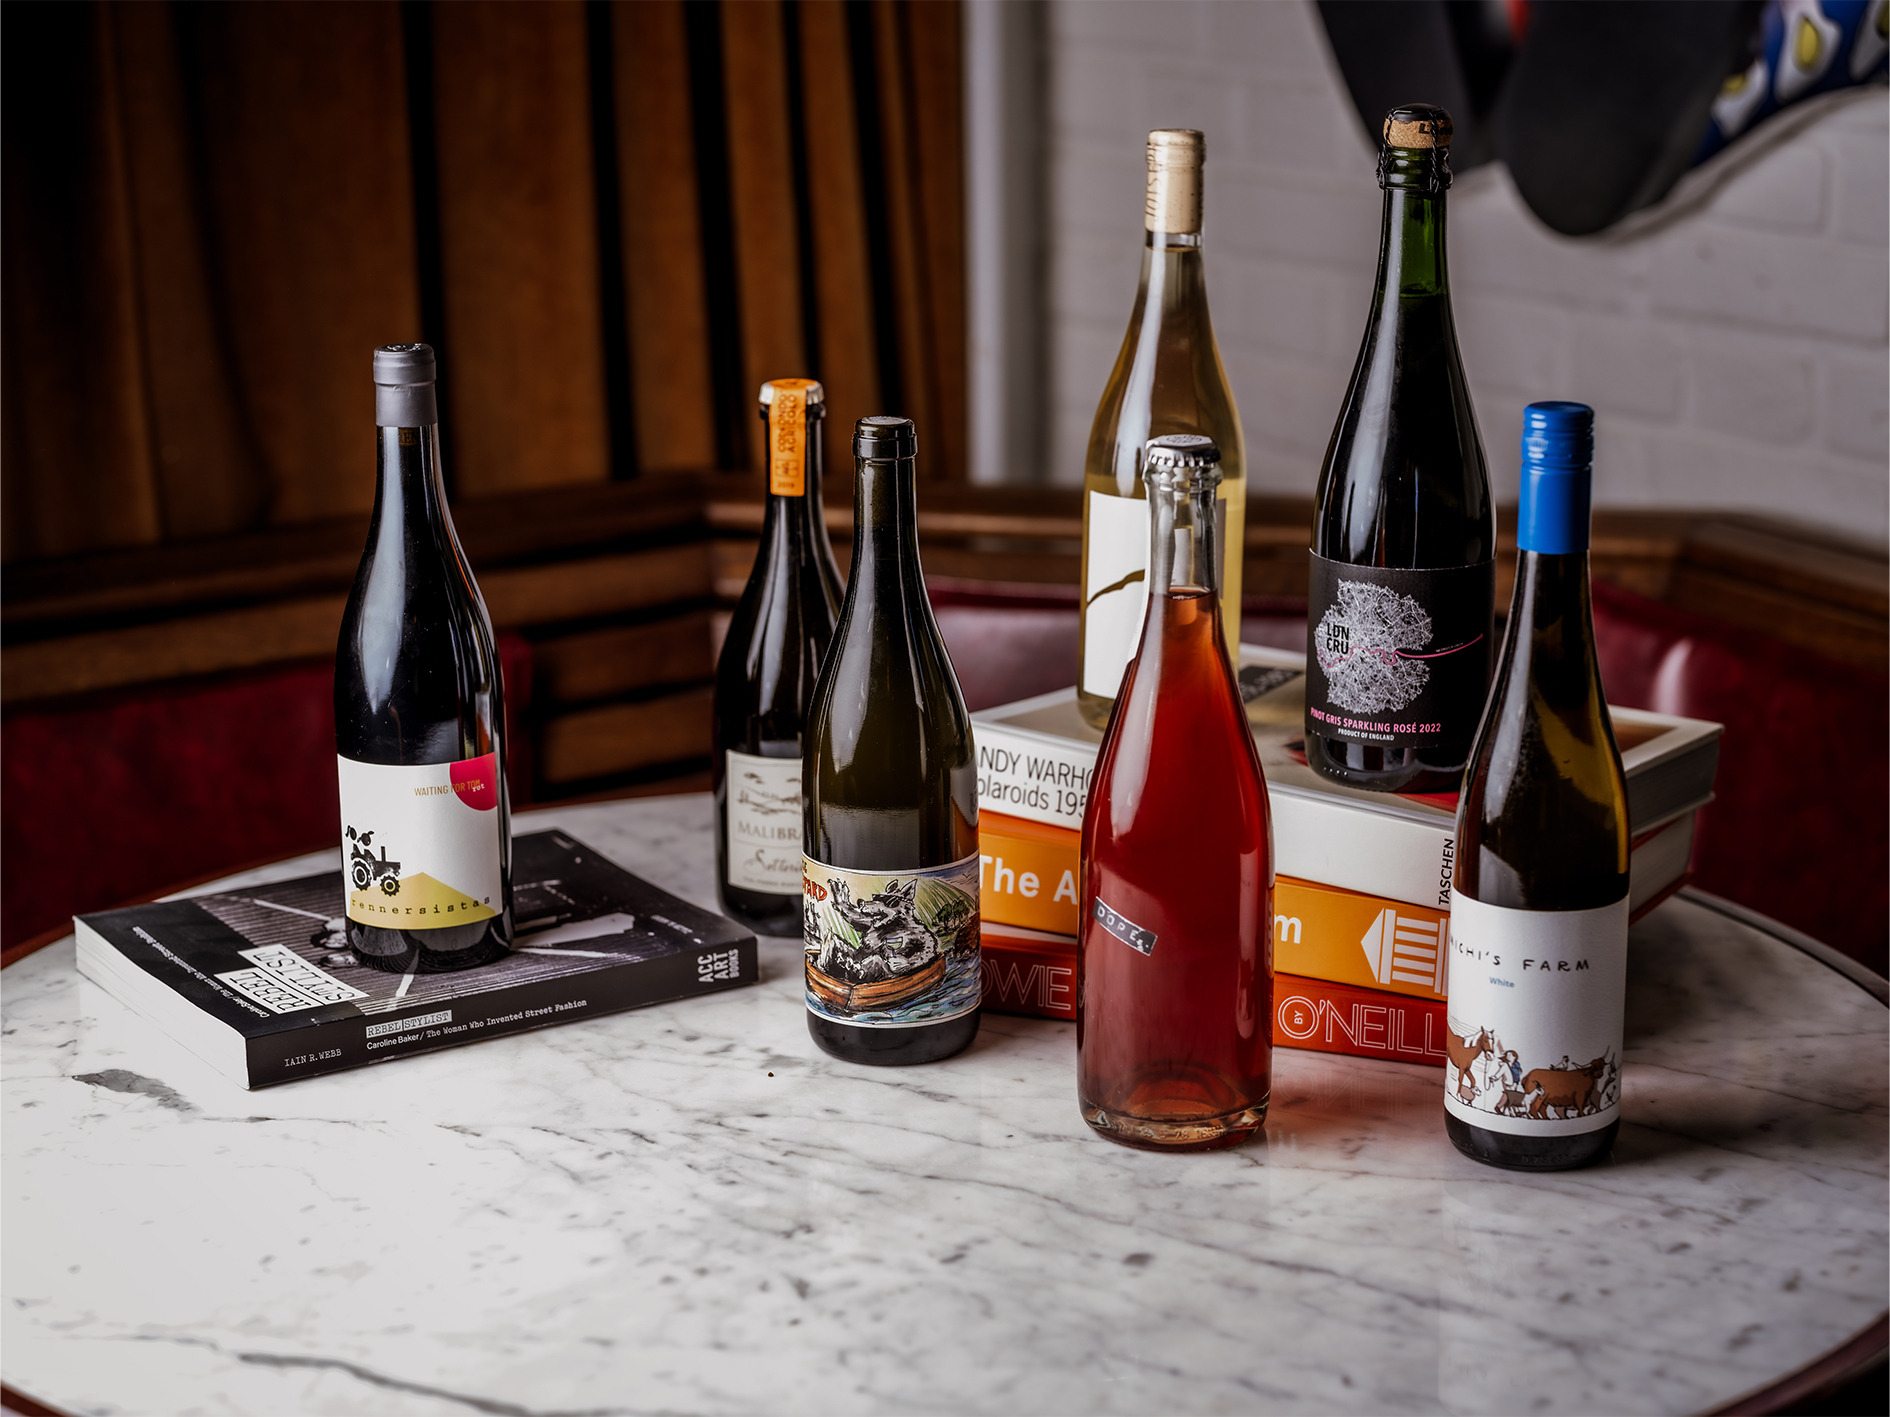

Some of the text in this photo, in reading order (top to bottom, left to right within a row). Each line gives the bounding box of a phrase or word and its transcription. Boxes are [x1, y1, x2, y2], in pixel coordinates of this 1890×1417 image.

[1326, 622, 1349, 640] LDN
[1326, 638, 1349, 654] CRU
[1310, 706, 1442, 734] PINOT GRIS SPARKLING ROSÉ 2022
[1338, 728, 1360, 738] PRODUCT
[979, 746, 1021, 775] NDY
[414, 785, 448, 796] WAITING
[450, 782, 466, 794] FOR
[979, 854, 1040, 898] The
[1438, 838, 1454, 905] TASCHEN
[803, 876, 828, 901] TARD
[351, 896, 490, 915] rennersistas
[252, 950, 355, 1002] STYLIST
[697, 954, 714, 982] ACC
[713, 952, 728, 979] ART
[728, 949, 740, 978] BOOKS
[1523, 959, 1590, 971] FARM
[229, 971, 312, 1011] REBEL
[1489, 976, 1515, 988] White
[366, 1038, 397, 1050] Caroline
[426, 1030, 441, 1038] The
[443, 1024, 468, 1034] Woman
[469, 1021, 484, 1029] Who
[486, 1012, 524, 1026] Invented
[525, 1006, 553, 1018] Street
[554, 1000, 588, 1012] Fashion
[367, 1012, 449, 1037] REBEL STYLIST
[1294, 1010, 1303, 1024] BY
[284, 1055, 306, 1067] IAIN
[318, 1048, 342, 1060] WEBB
